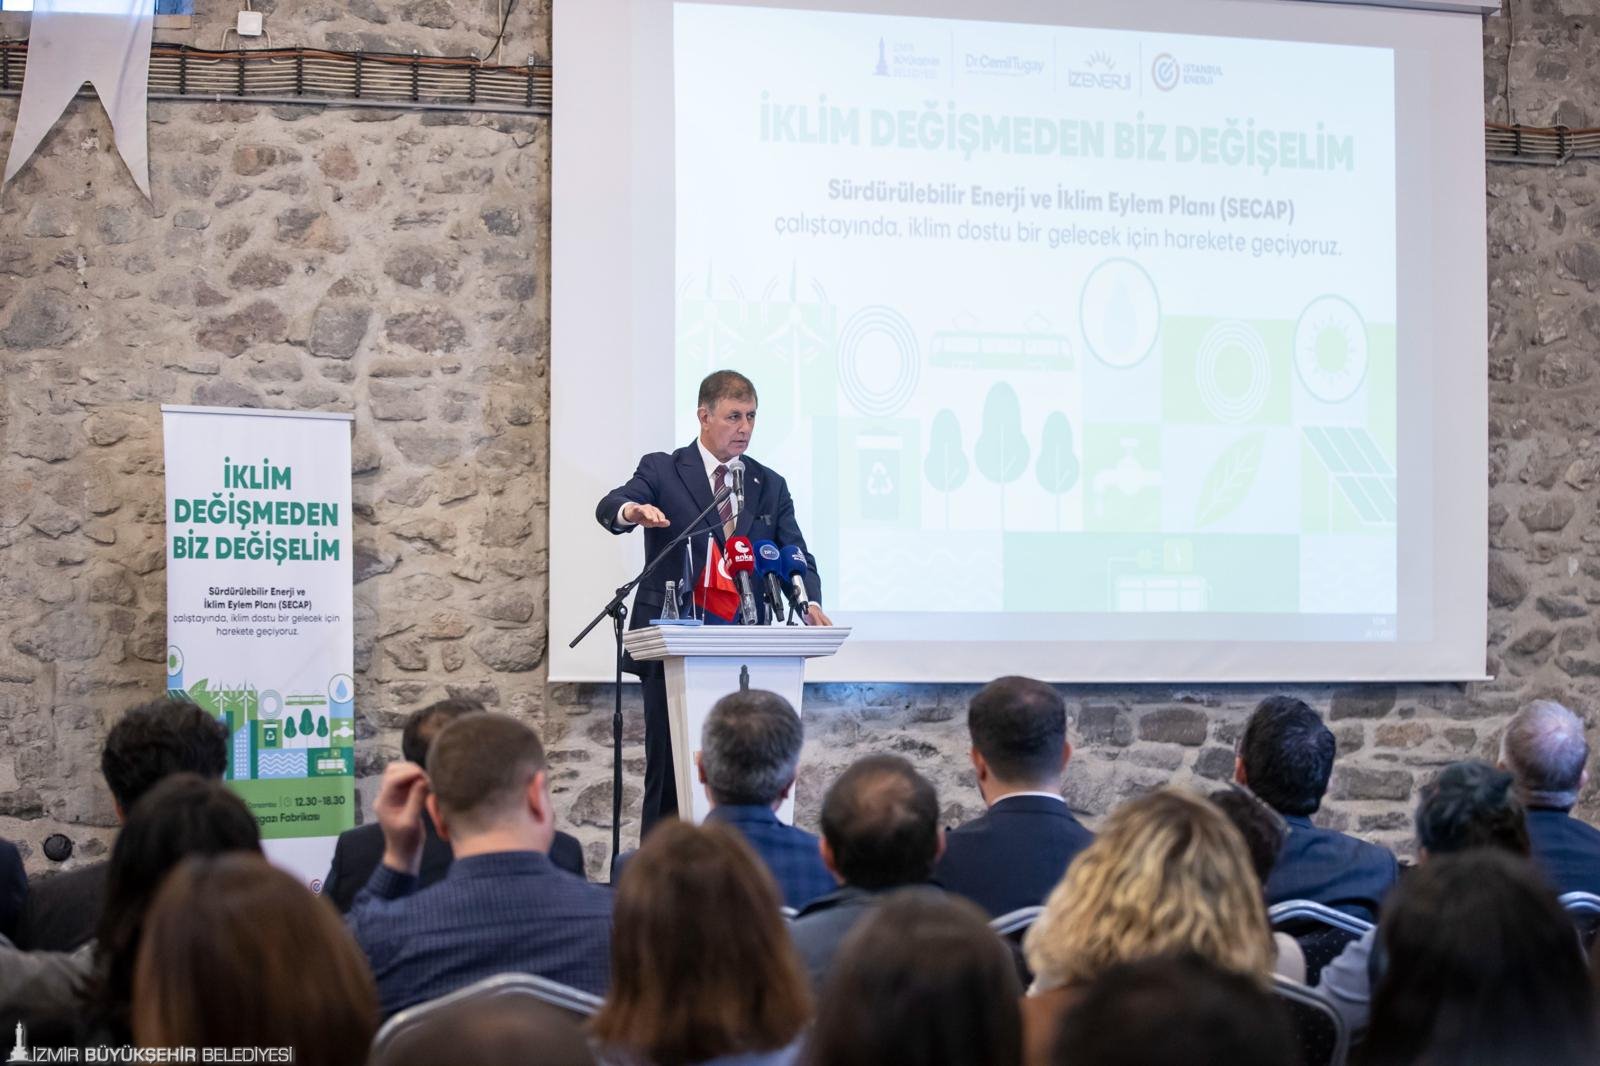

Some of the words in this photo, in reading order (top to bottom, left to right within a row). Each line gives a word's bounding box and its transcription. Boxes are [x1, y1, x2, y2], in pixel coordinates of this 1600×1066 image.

[759, 89, 860, 146] İKLİM
[870, 99, 1104, 162] DEĞİŞMEDEN
[1113, 110, 1167, 162] BİZ
[1175, 117, 1354, 176] DEĞİŞELİM
[828, 178, 966, 206] Sürdürülebilir
[971, 185, 1026, 213] Enerji
[1031, 193, 1052, 210] ve
[1056, 182, 1103, 211] İklim
[1108, 192, 1164, 217] Eylem
[1169, 195, 1215, 217] Planı
[1220, 196, 1296, 226] (SECAP)
[908, 217, 951, 239] iklim
[958, 219, 1011, 242] dostu
[1017, 221, 1042, 243] bir
[1048, 223, 1121, 249] gelecek
[1126, 228, 1160, 251] için
[1164, 228, 1247, 252] harekete
[1251, 237, 1343, 257] geçiyoruz.
[223, 456, 292, 490] İKLİM
[174, 492, 339, 530] DEĞİŞMEDEN
[173, 529, 209, 560] BİZ
[215, 530, 340, 566] DEĞİŞELİM
[203, 598, 226, 609] İklim
[228, 600, 253, 611] Eylem
[254, 600, 277, 610] Planı
[278, 600, 312, 611] (SECAP)
[208, 586, 269, 597] Sürdürülebilir
[270, 587, 295, 598] Enerji
[296, 589, 306, 597] ve
[173, 613, 229, 625] çalıştayında,
[230, 613, 250, 623] iklim
[251, 614, 276, 623] dostu
[278, 613, 290, 623] bir
[291, 614, 323, 625] gelecek
[324, 614, 340, 624] için
[216, 627, 254, 637] harekete
[256, 628, 299, 638] geçiyoruz.
[280, 812, 320, 823] Fabrikası
